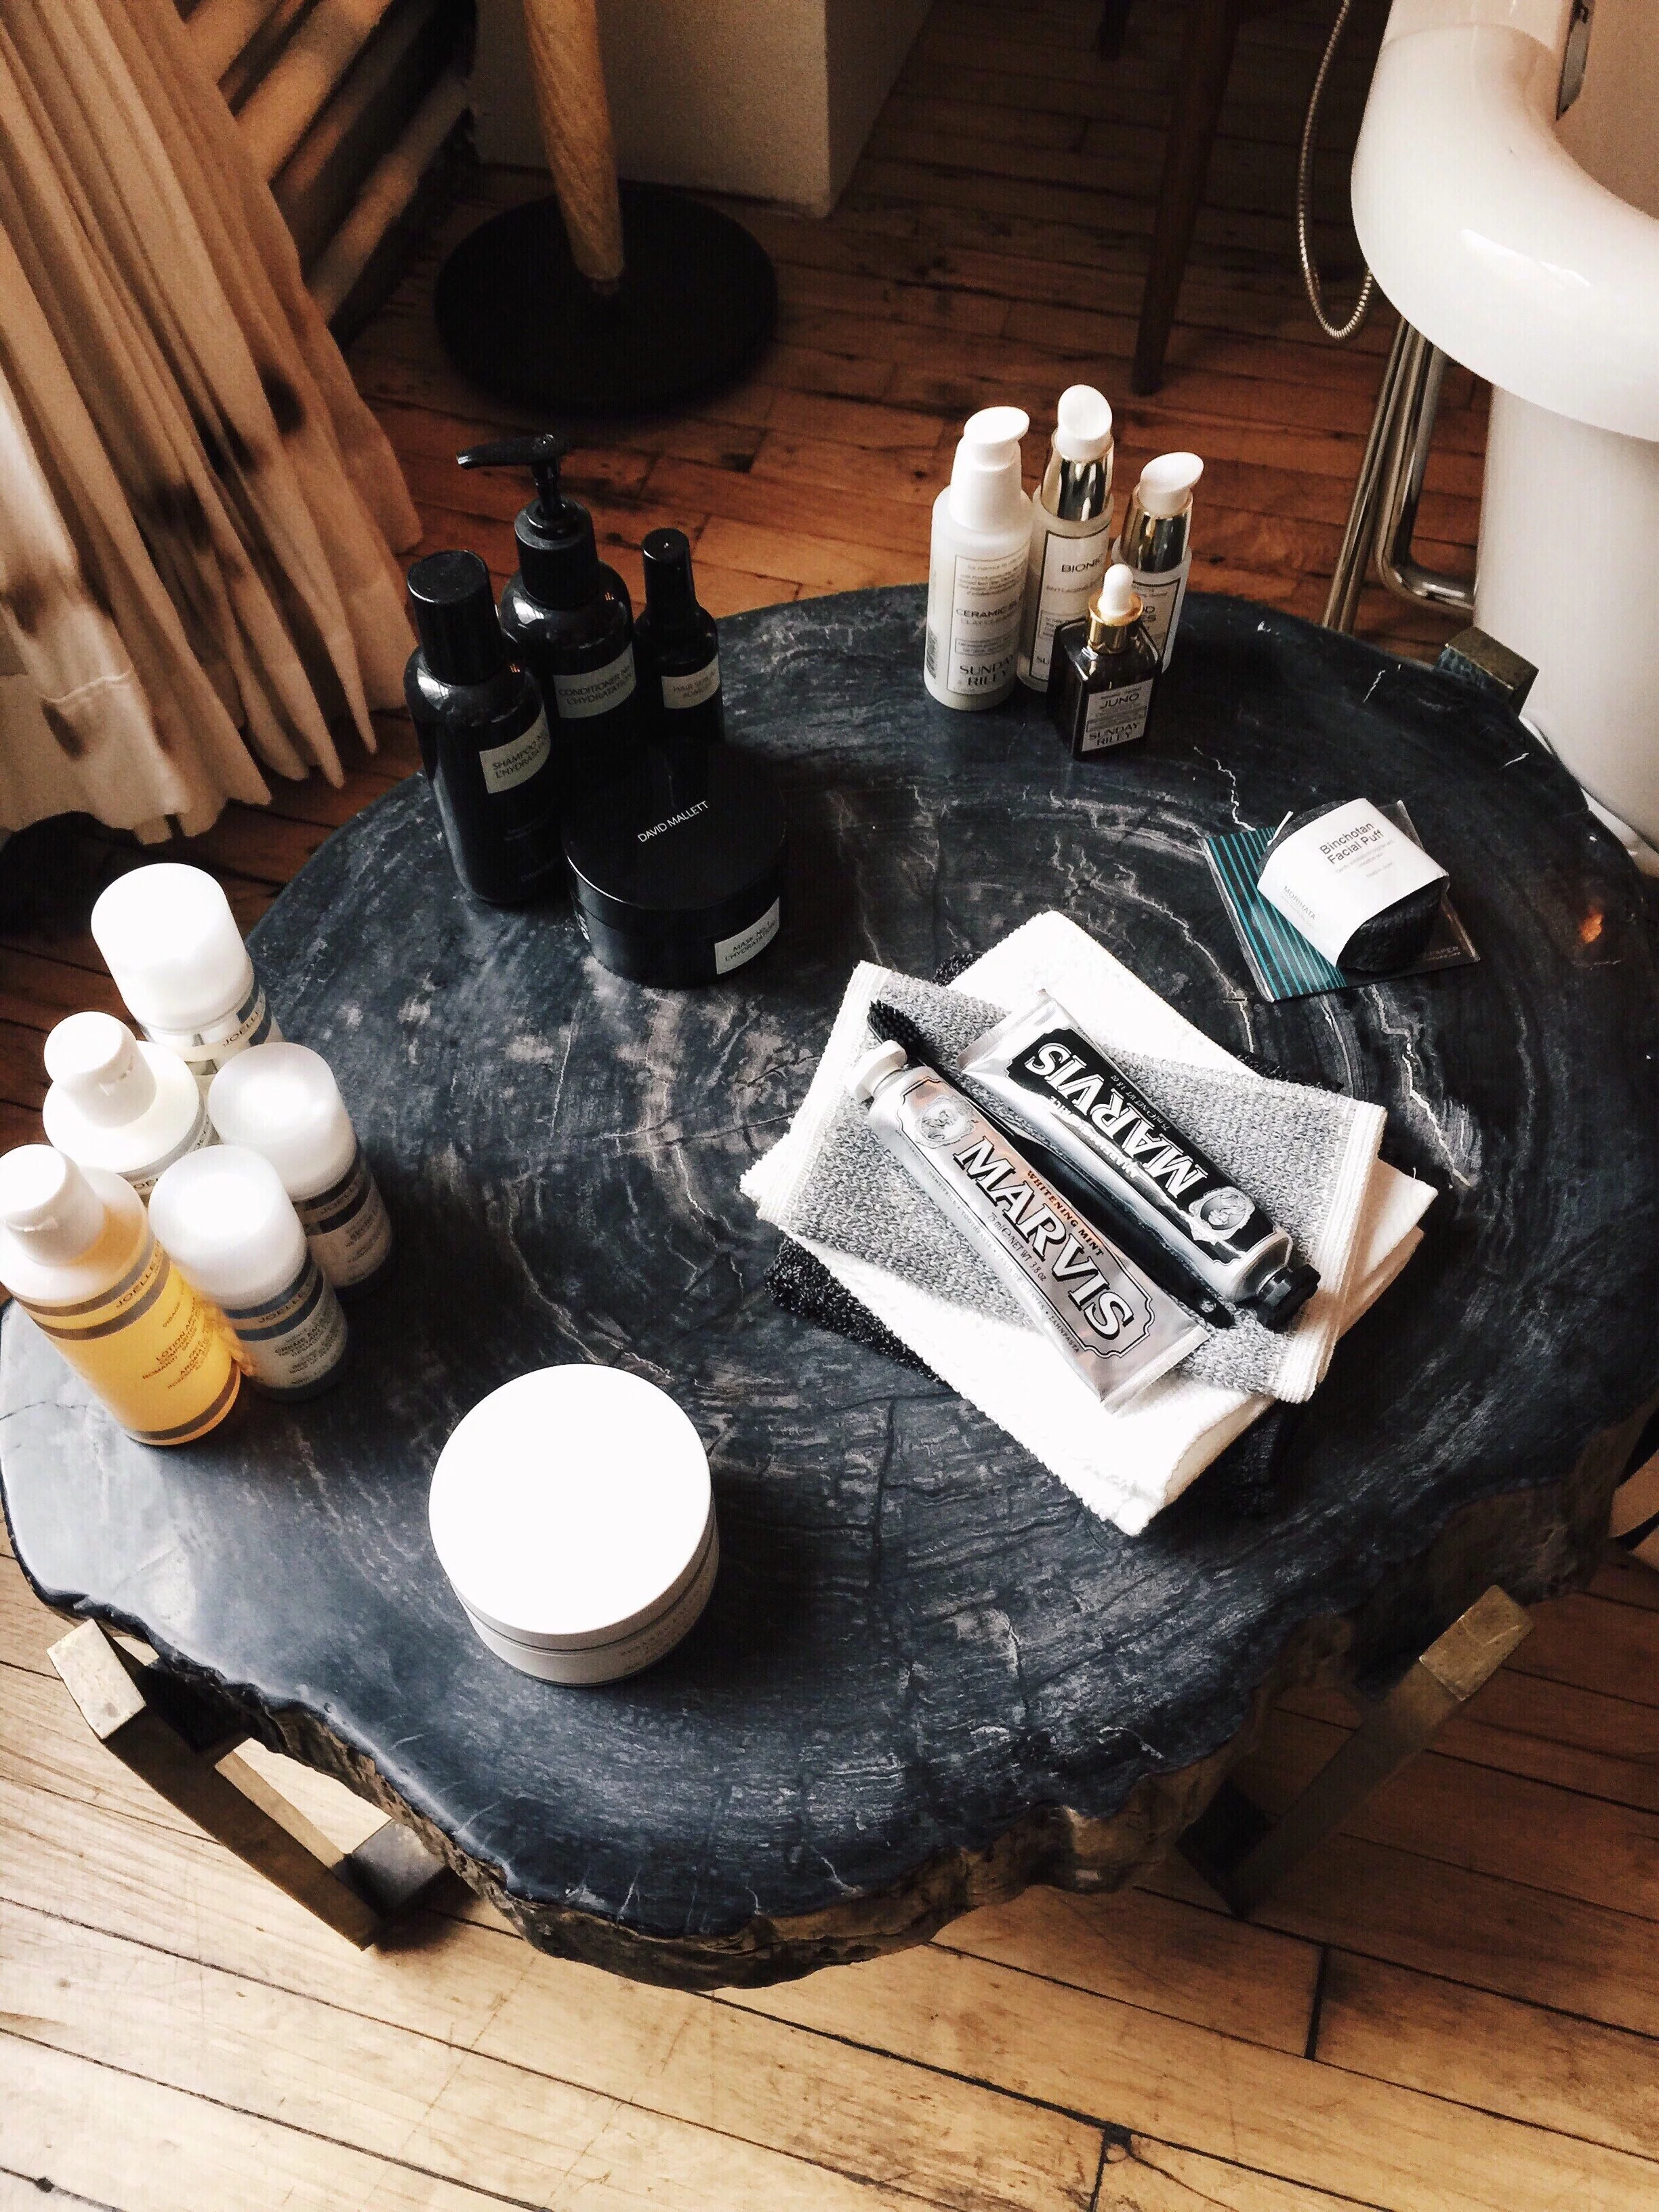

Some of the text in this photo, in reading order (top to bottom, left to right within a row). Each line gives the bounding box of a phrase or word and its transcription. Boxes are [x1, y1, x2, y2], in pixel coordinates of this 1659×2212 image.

[1099, 693, 1140, 710] JUNO
[1089, 722, 1139, 739] SUNDAY
[1097, 732, 1130, 746] RILEY
[637, 800, 708, 842] DAVID MALLETT
[1319, 823, 1374, 855] Binchotan
[1327, 841, 1362, 865] Facial
[1360, 829, 1385, 846] Puff
[1284, 885, 1315, 920] MORIHATA
[1024, 1042, 1209, 1199] MARVIS
[1027, 1170, 1105, 1256] WHITENING MINT
[952, 1135, 1135, 1340] MARVIS
[1029, 1261, 1042, 1273] 3.8
[1038, 1272, 1047, 1282] oz
[155, 1331, 186, 1361] LOTION
[1048, 1315, 1080, 1353] ZAHNPASTA
